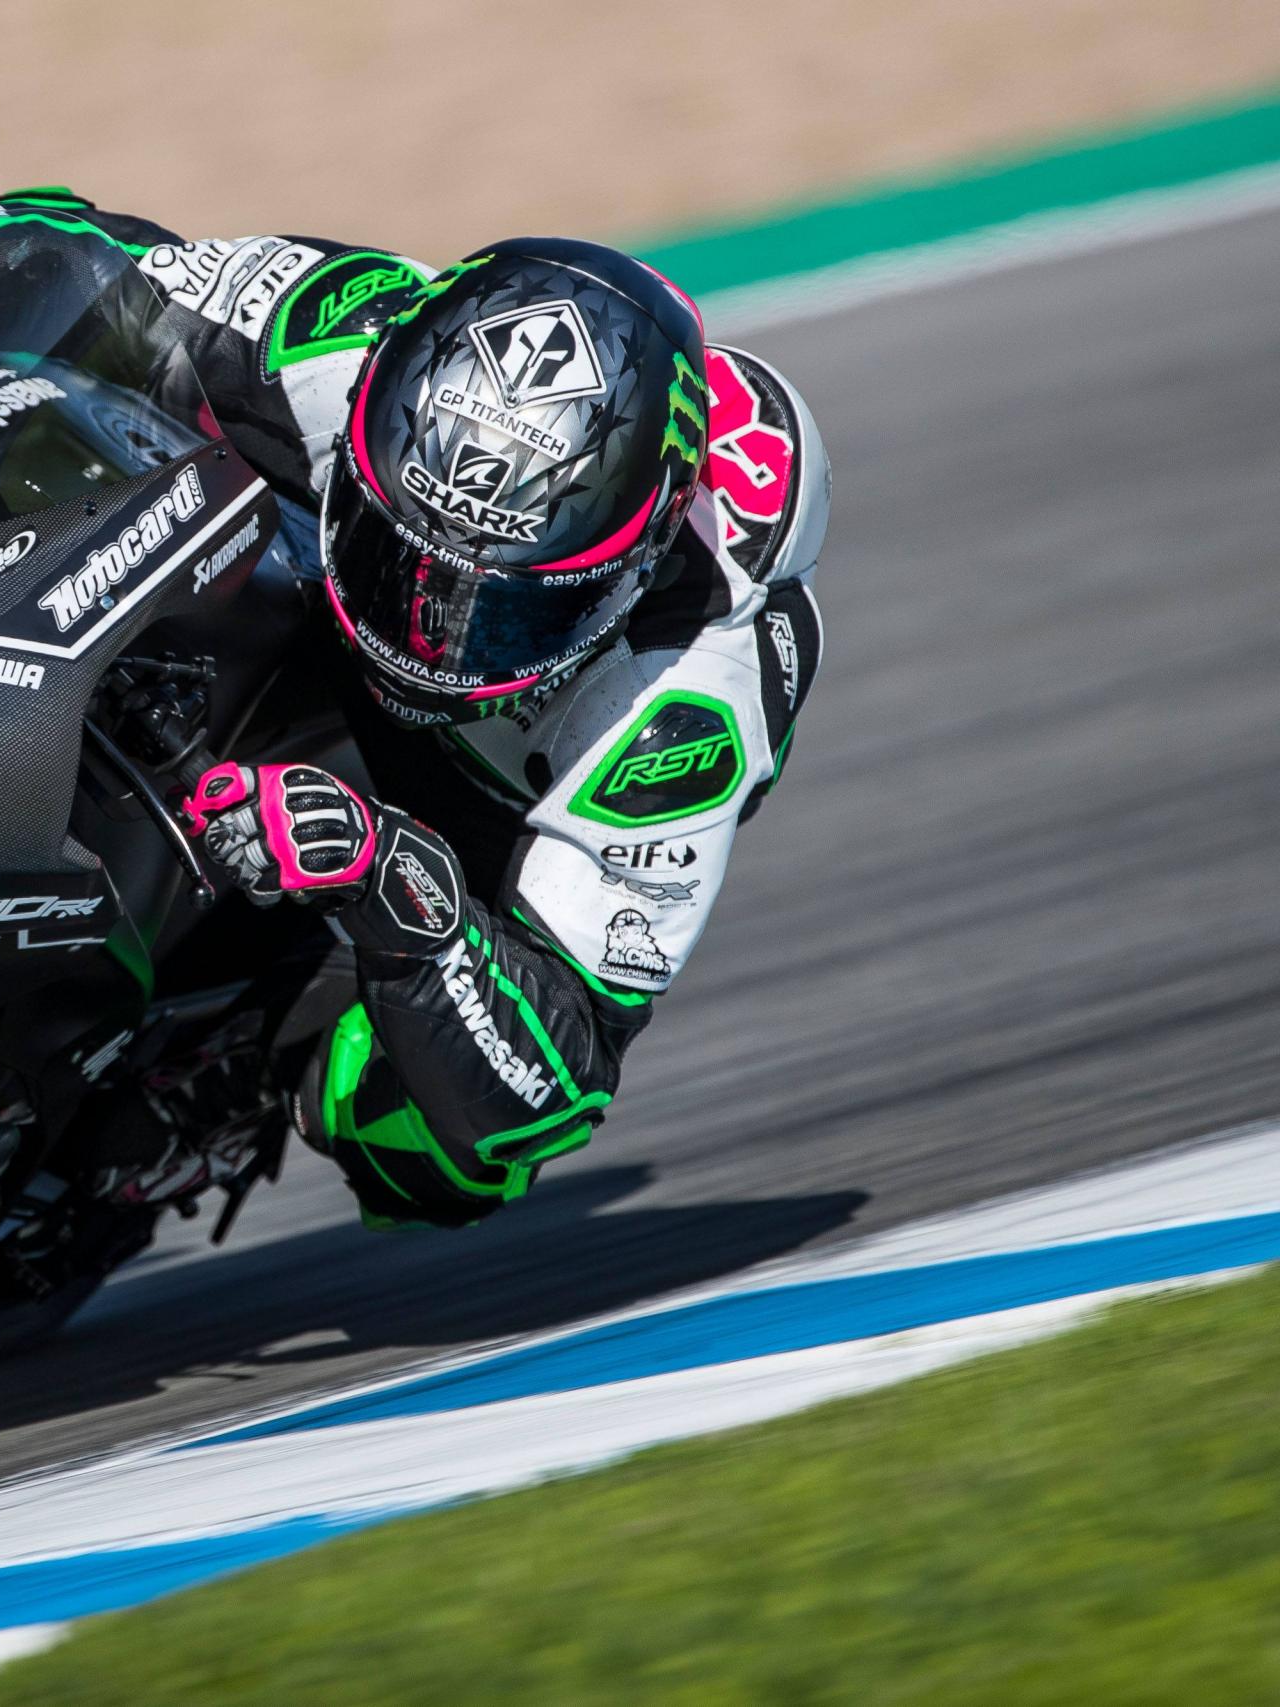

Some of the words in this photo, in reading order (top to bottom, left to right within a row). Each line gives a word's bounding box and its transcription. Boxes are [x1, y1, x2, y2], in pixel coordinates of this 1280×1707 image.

[309, 264, 415, 338] RST
[439, 388, 465, 407] GP
[470, 399, 566, 456] TITANTECH
[403, 463, 544, 541] SHARK
[394, 522, 476, 574] easy-trim
[542, 558, 623, 587] easy-trim
[355, 619, 486, 687] WWW.JUTA.CO.UK
[604, 730, 732, 797] RST
[394, 852, 455, 914] RST
[434, 937, 558, 1111] Kawasaki
